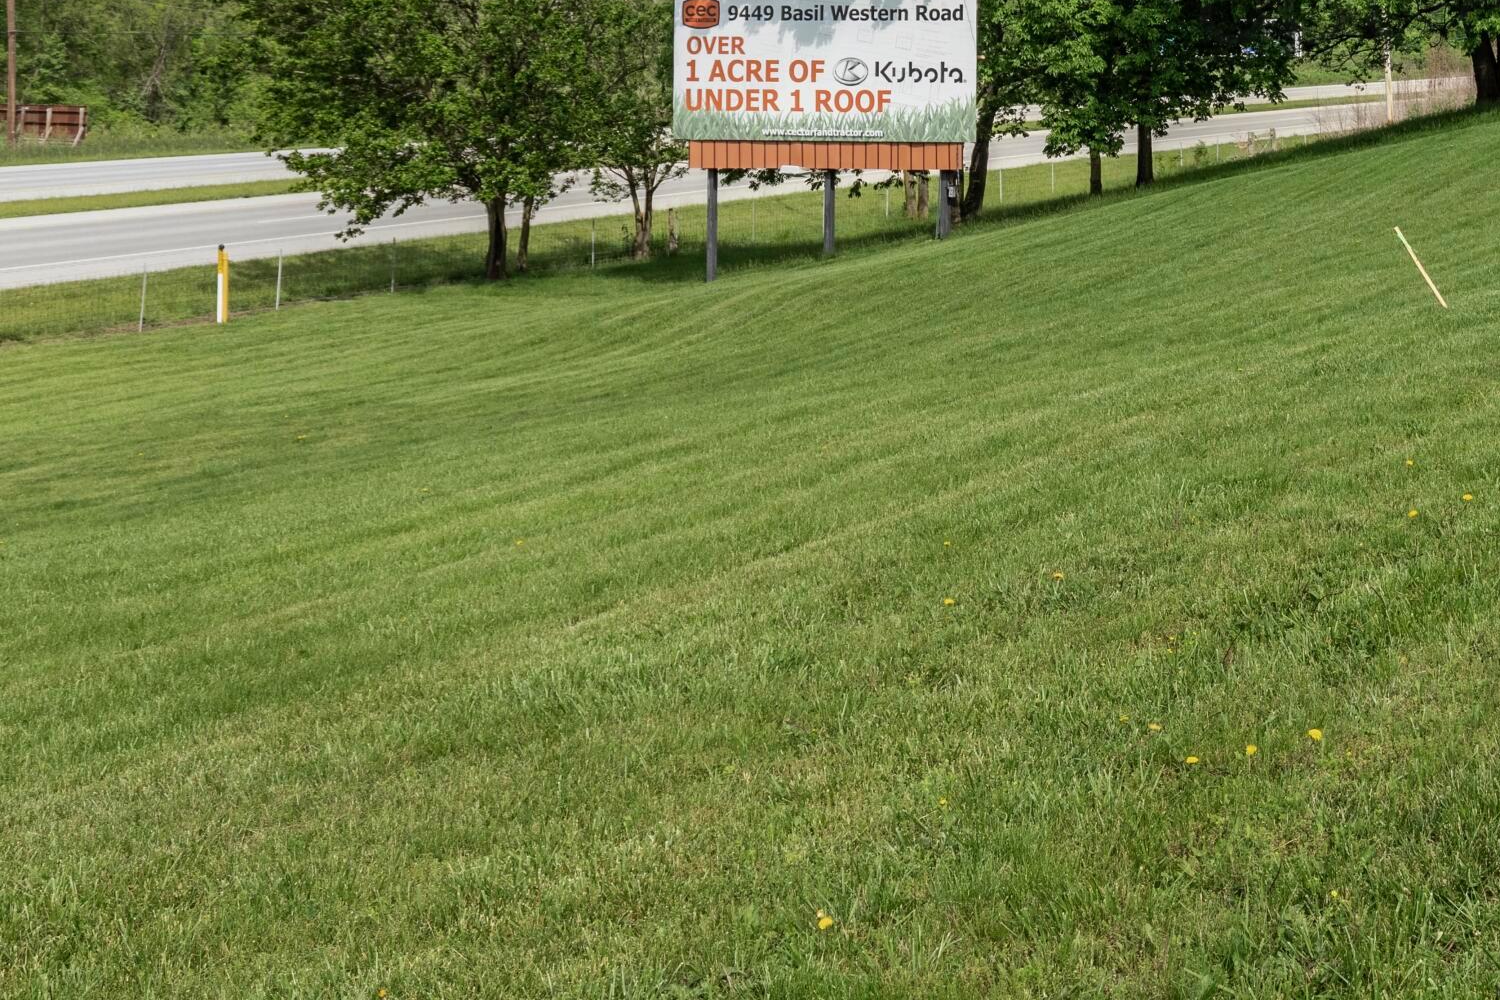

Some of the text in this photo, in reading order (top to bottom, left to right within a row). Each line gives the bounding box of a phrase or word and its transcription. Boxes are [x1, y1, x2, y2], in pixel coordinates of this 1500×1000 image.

[685, 5, 717, 17] cec
[727, 4, 964, 21] 9449 Basil Western Road
[686, 36, 745, 55] OVER
[686, 59, 825, 83] 1 ACRE OF
[874, 61, 964, 83] Kubota
[686, 88, 892, 113] UNDER 1 ROOF
[761, 127, 884, 137] www.cecturfandtractor.com
